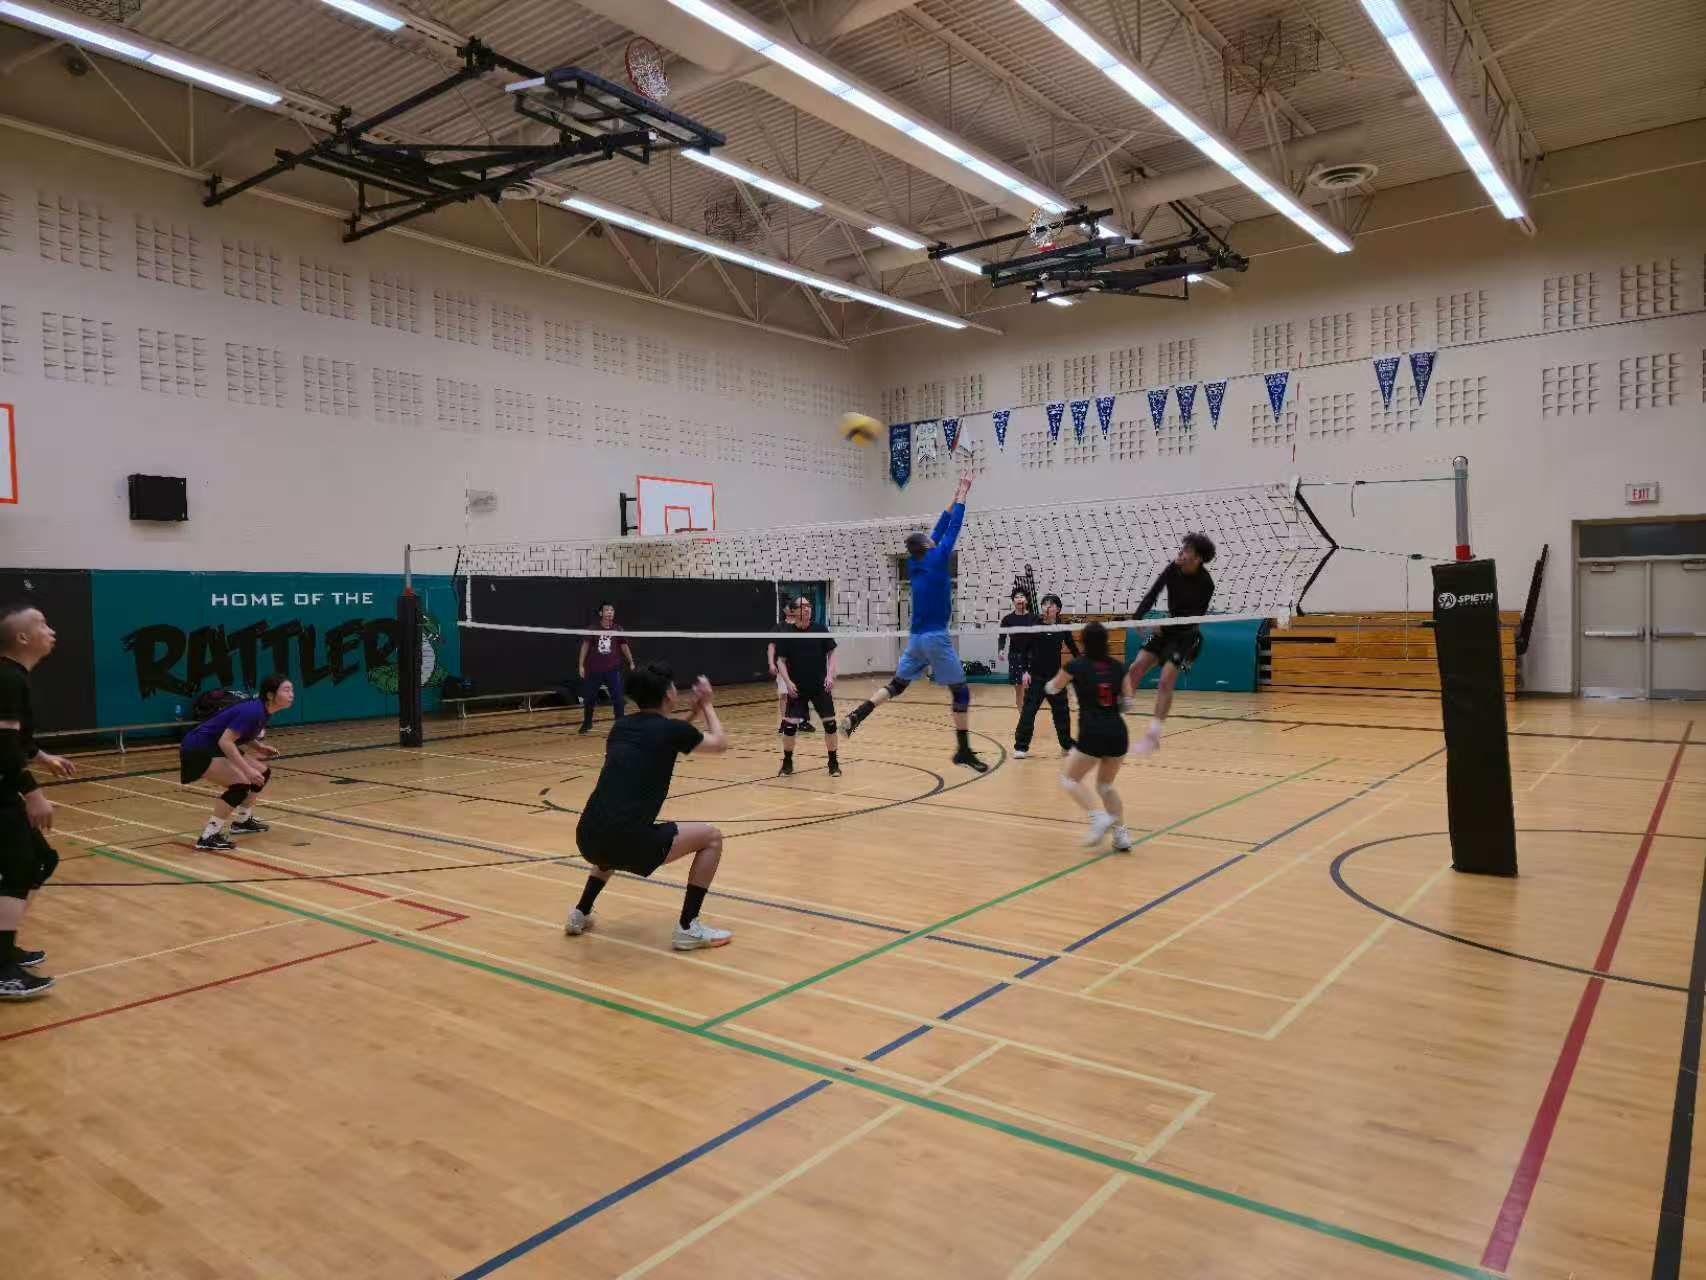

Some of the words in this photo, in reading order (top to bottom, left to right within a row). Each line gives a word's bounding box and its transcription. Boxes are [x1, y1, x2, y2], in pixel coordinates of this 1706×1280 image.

[1632, 488, 1650, 500] EXIT
[211, 593, 284, 607] HOME
[294, 592, 324, 606] OF
[331, 591, 373, 605] THE
[1457, 592, 1494, 604] SPIETH
